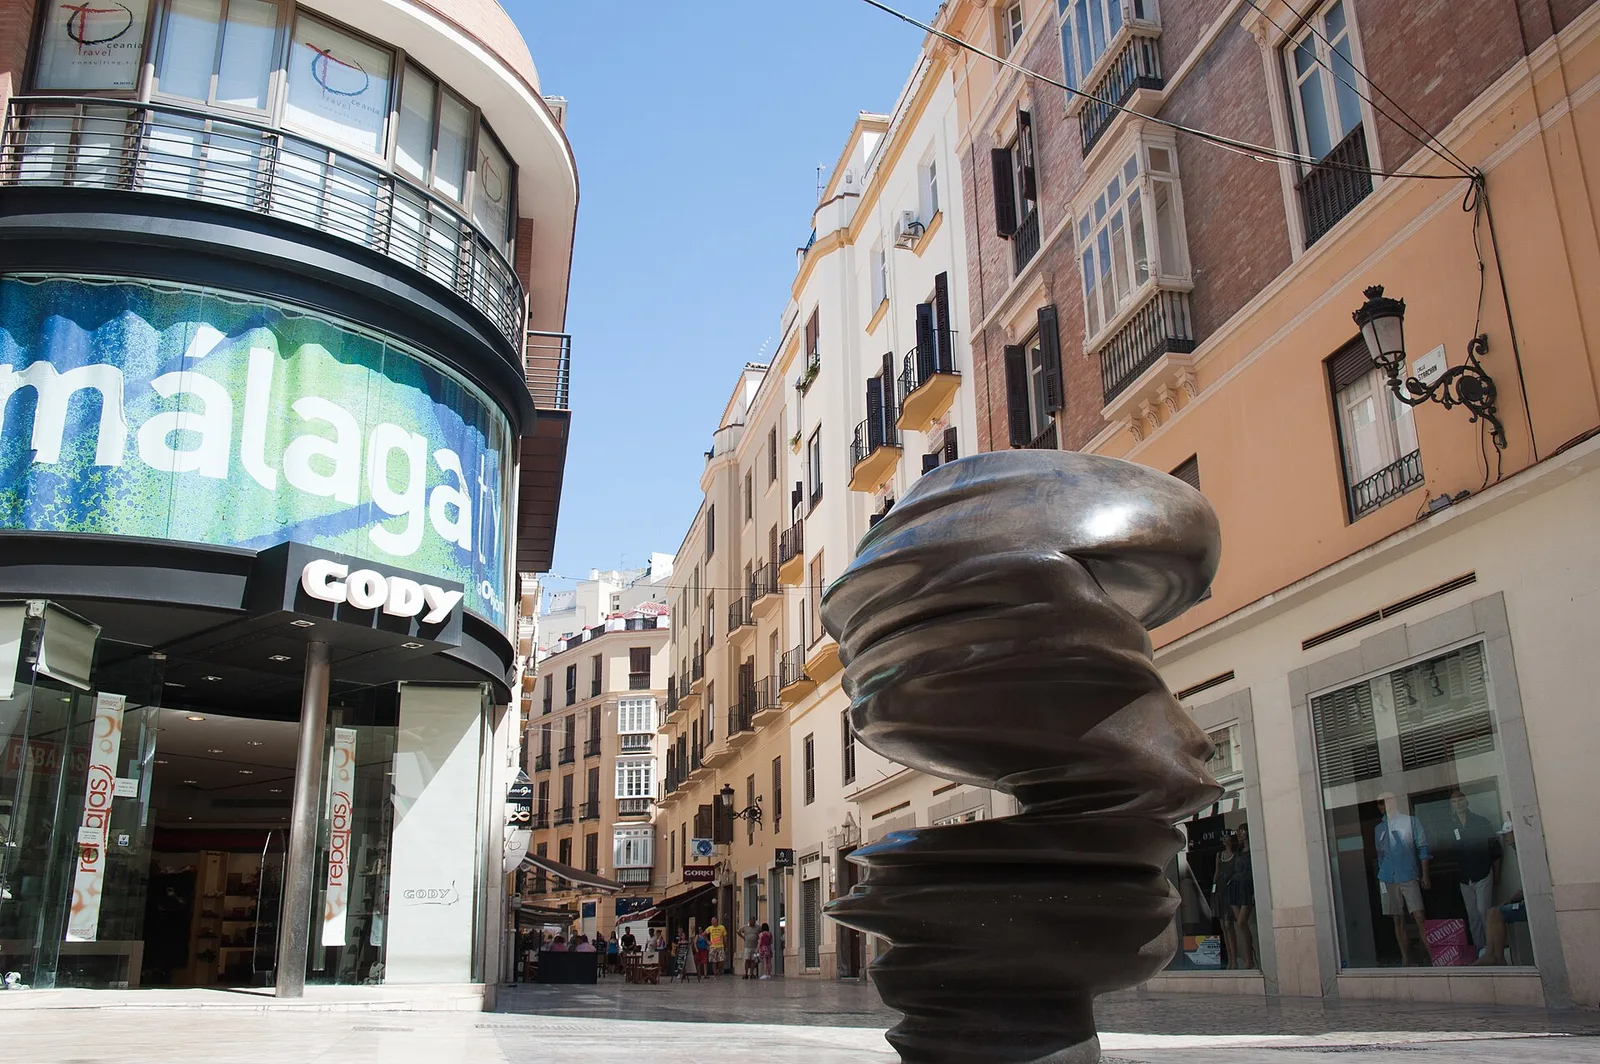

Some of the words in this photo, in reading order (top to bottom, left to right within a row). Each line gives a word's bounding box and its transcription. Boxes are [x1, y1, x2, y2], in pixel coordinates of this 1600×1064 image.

[0, 326, 472, 557] málaga
[301, 558, 465, 625] GODY
[329, 803, 351, 887] rebajas
[684, 869, 714, 877] GORKI
[403, 888, 451, 900] GODY
